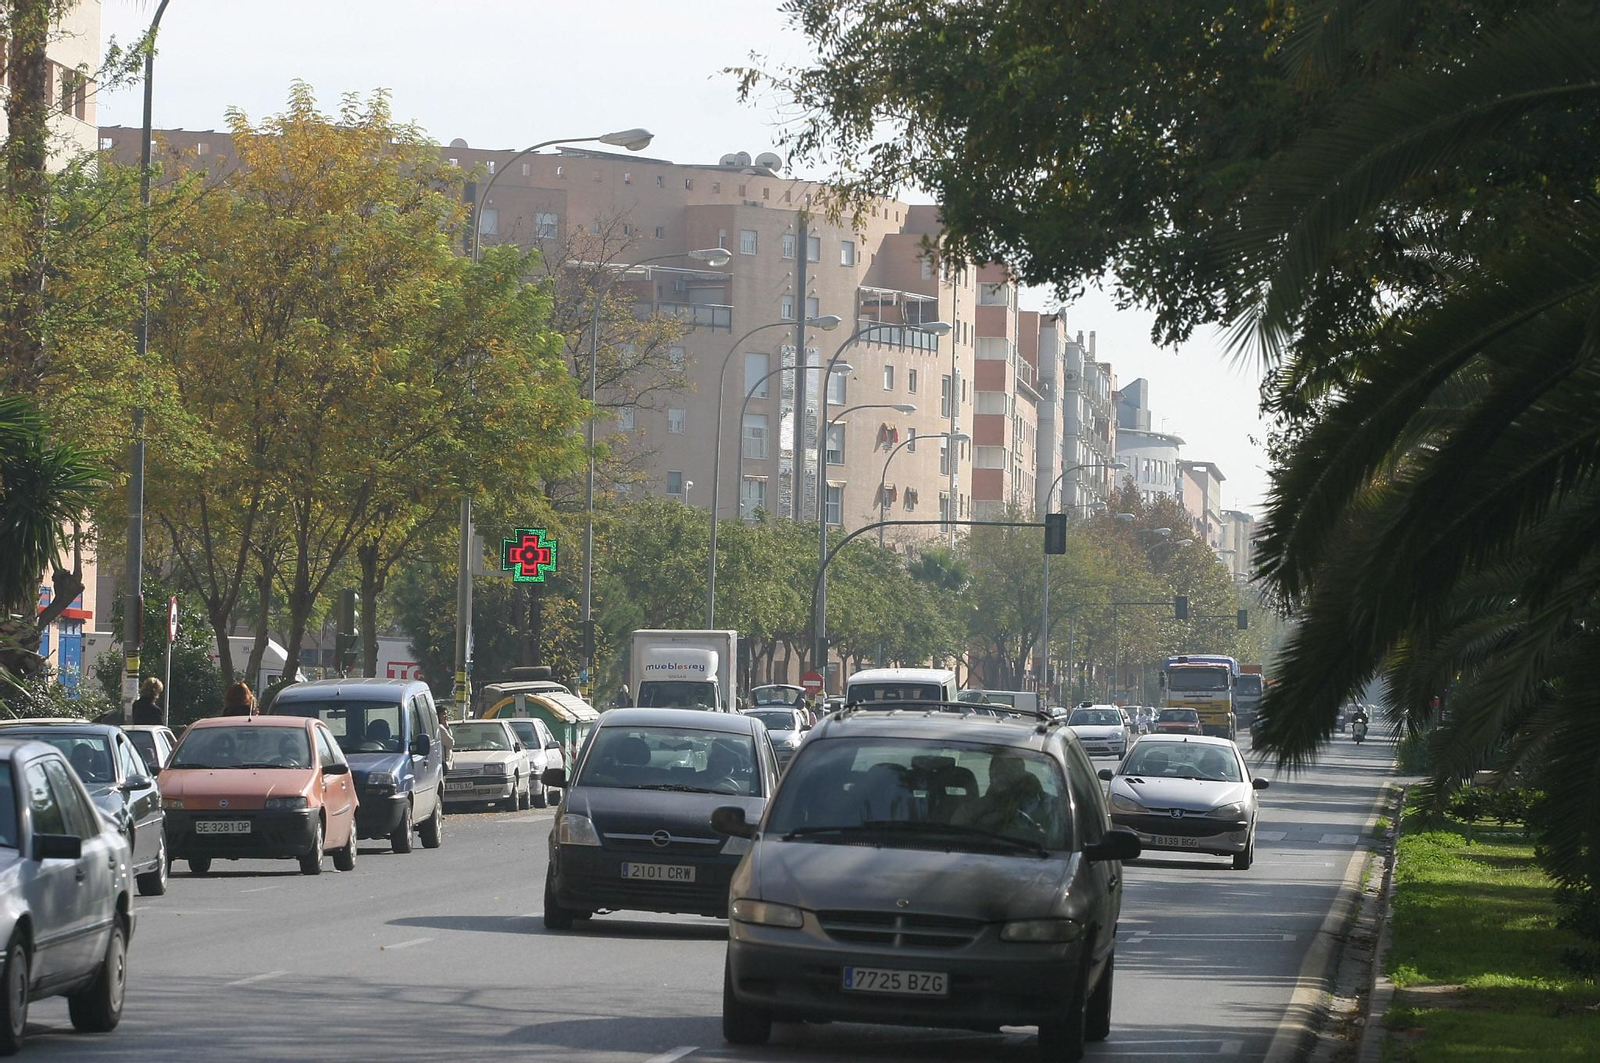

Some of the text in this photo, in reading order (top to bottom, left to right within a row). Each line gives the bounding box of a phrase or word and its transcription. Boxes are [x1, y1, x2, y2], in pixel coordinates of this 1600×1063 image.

[645, 662, 705, 672] mueblesrey
[1157, 836, 1179, 846] 8139
[632, 865, 691, 880] 2101 CRW
[855, 970, 943, 992] 7725 BZG
